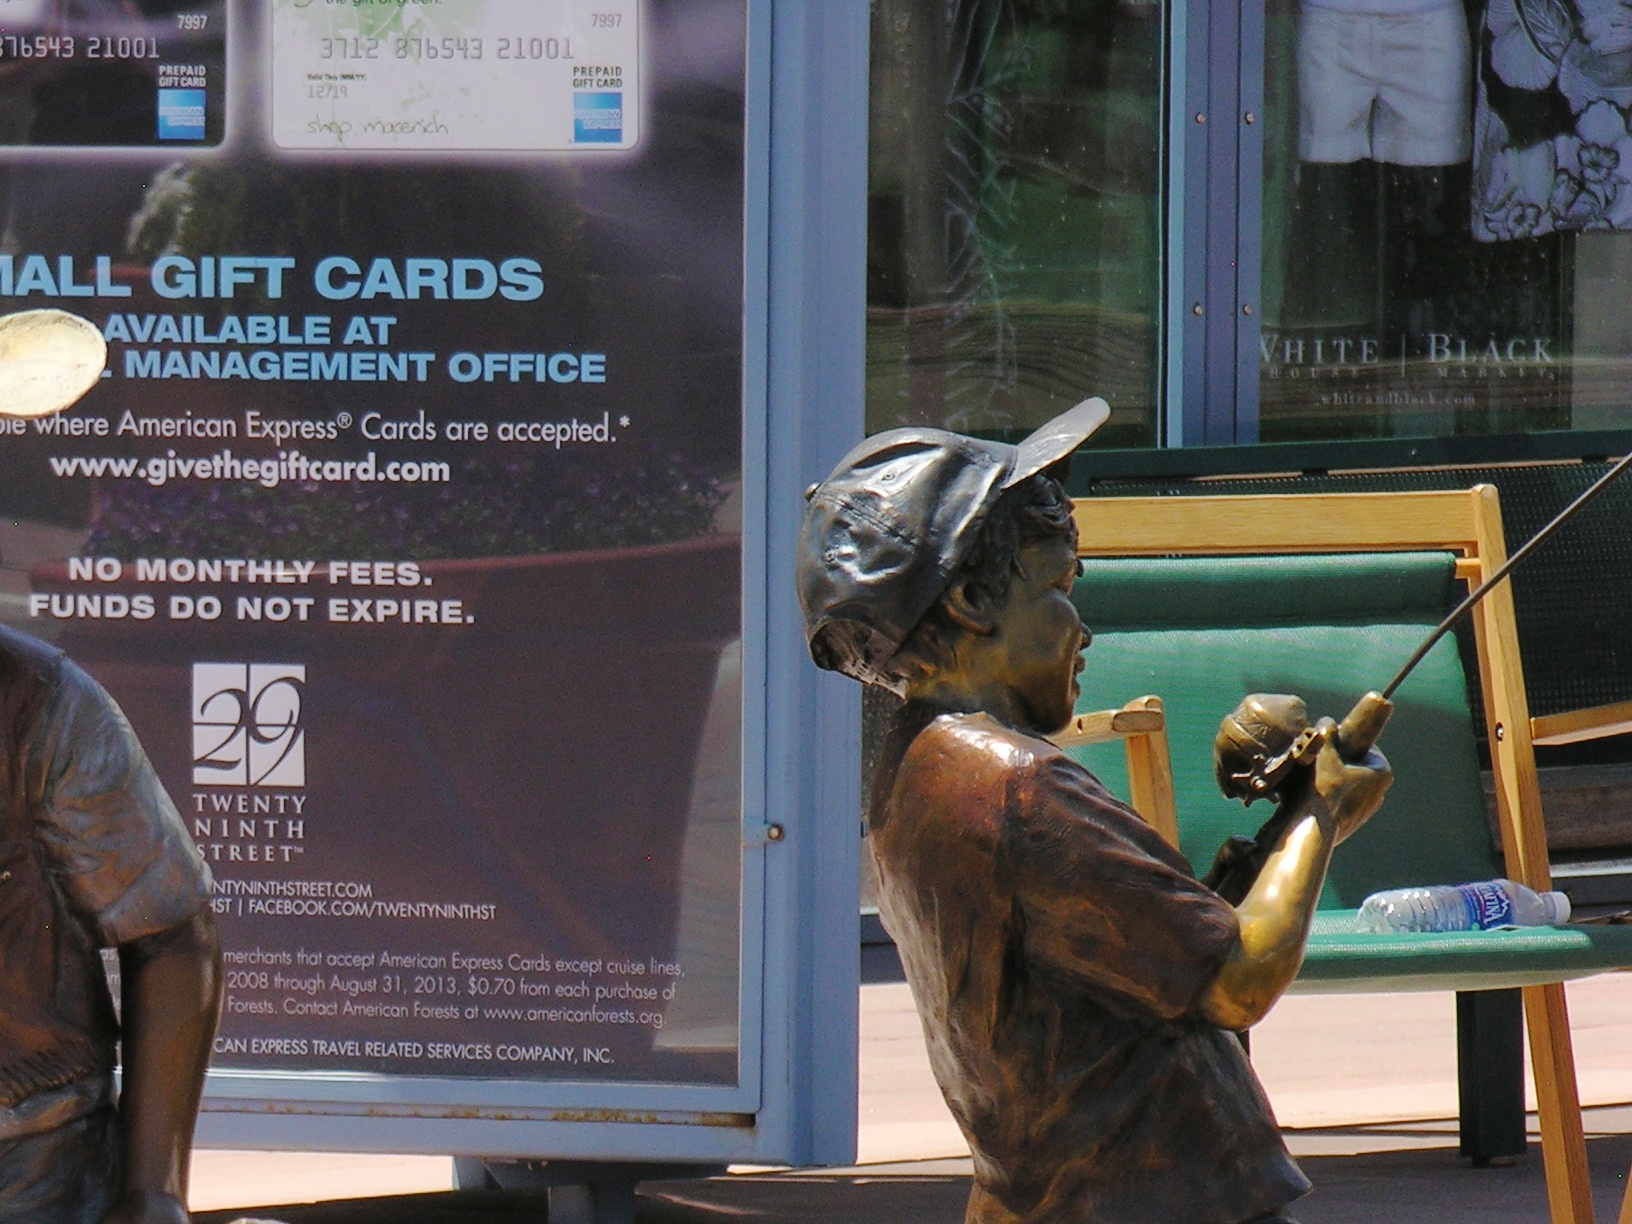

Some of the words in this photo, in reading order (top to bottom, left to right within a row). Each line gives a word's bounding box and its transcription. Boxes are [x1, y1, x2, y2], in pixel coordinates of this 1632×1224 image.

[177, 15, 208, 30] 7997
[590, 13, 623, 28] 7997
[87, 38, 160, 59] 21001
[320, 38, 379, 60] 3712
[396, 38, 483, 60] 876543
[497, 38, 575, 60] 21001
[158, 65, 207, 76] PREPAID
[158, 76, 179, 88] GIFT
[180, 76, 207, 88] CARD
[572, 66, 623, 77] PREPAID
[307, 85, 348, 98] 12/19
[572, 78, 594, 89] GIFT
[596, 78, 623, 89] CARD
[151, 256, 295, 298] GIFT
[314, 256, 545, 301] CARDS
[104, 313, 330, 345] AVAILABLE
[343, 316, 396, 346] AT
[1428, 333, 1554, 364] BLACK
[125, 350, 435, 382] MANAGEMENT
[448, 353, 606, 384] OFFICE
[34, 411, 109, 436] where
[117, 410, 237, 438] American
[361, 409, 437, 440] Cards
[445, 420, 489, 441] are
[50, 449, 450, 487] www.givethegiftcard.com
[68, 557, 122, 582] NO
[137, 558, 316, 585] MONTHLY
[329, 561, 433, 586] FEES.
[29, 593, 156, 619] FUNDS
[170, 595, 222, 620] DO
[237, 597, 315, 622] NOT
[328, 598, 475, 624] EXPIRE.
[193, 664, 305, 786] 29
[192, 793, 307, 814] TWENTY
[195, 818, 305, 839] NINTH
[248, 900, 497, 920] FACEBOOK.COM/TWENTYNINTHST
[223, 947, 292, 965] merchants
[297, 948, 323, 966] that
[327, 951, 375, 970] accept
[380, 951, 446, 969] American
[452, 952, 504, 973] Express
[508, 953, 551, 973] Cards
[555, 957, 602, 977] except
[607, 959, 645, 975] cruise
[650, 957, 685, 978] lines,
[227, 971, 269, 989] 2008
[274, 973, 325, 995] through
[330, 974, 378, 997] August
[382, 975, 407, 995] 31,
[414, 976, 461, 997] 2013,
[467, 976, 516, 997] $0.70
[520, 977, 551, 997] from
[555, 980, 590, 998] each
[595, 981, 658, 1003] purchase
[662, 982, 677, 1000] of
[227, 996, 278, 1014] Forests.
[283, 998, 338, 1015] Contact
[343, 1000, 409, 1018] American
[413, 1002, 460, 1020] Forests
[464, 1005, 479, 1019] at
[251, 1038, 309, 1055] EXPRESS
[312, 1039, 361, 1057] TRAVEL
[365, 1041, 424, 1058] RELATED
[427, 1043, 493, 1061] SERVICES
[496, 1045, 579, 1065] COMPANY,
[582, 1047, 615, 1064] INC.
